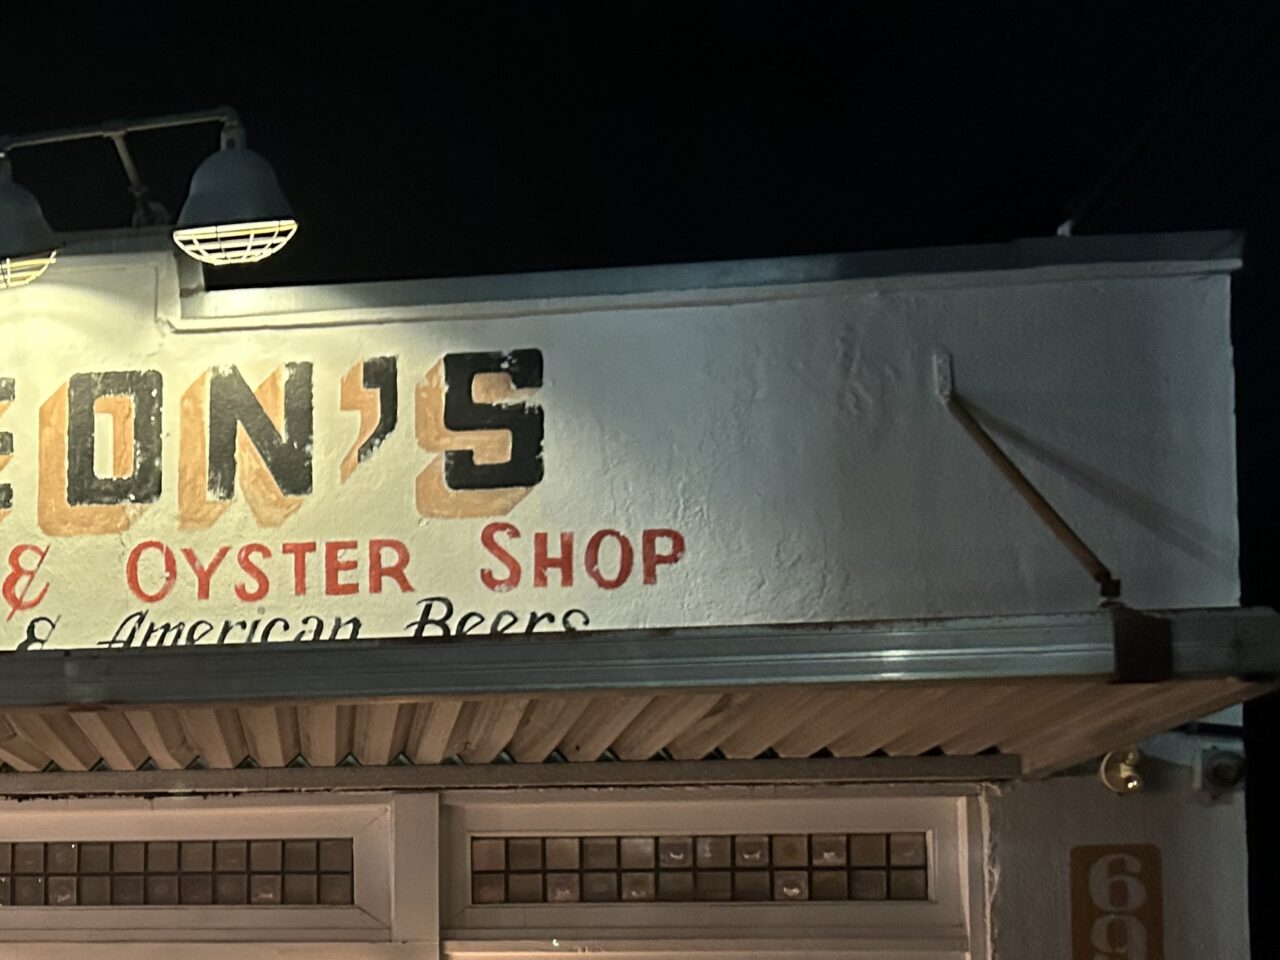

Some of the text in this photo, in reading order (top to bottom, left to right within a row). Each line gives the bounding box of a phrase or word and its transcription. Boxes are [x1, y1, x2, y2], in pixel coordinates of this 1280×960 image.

[1, 543, 50, 622] &
[126, 538, 415, 603] OYSTER
[480, 521, 686, 593] SHOP
